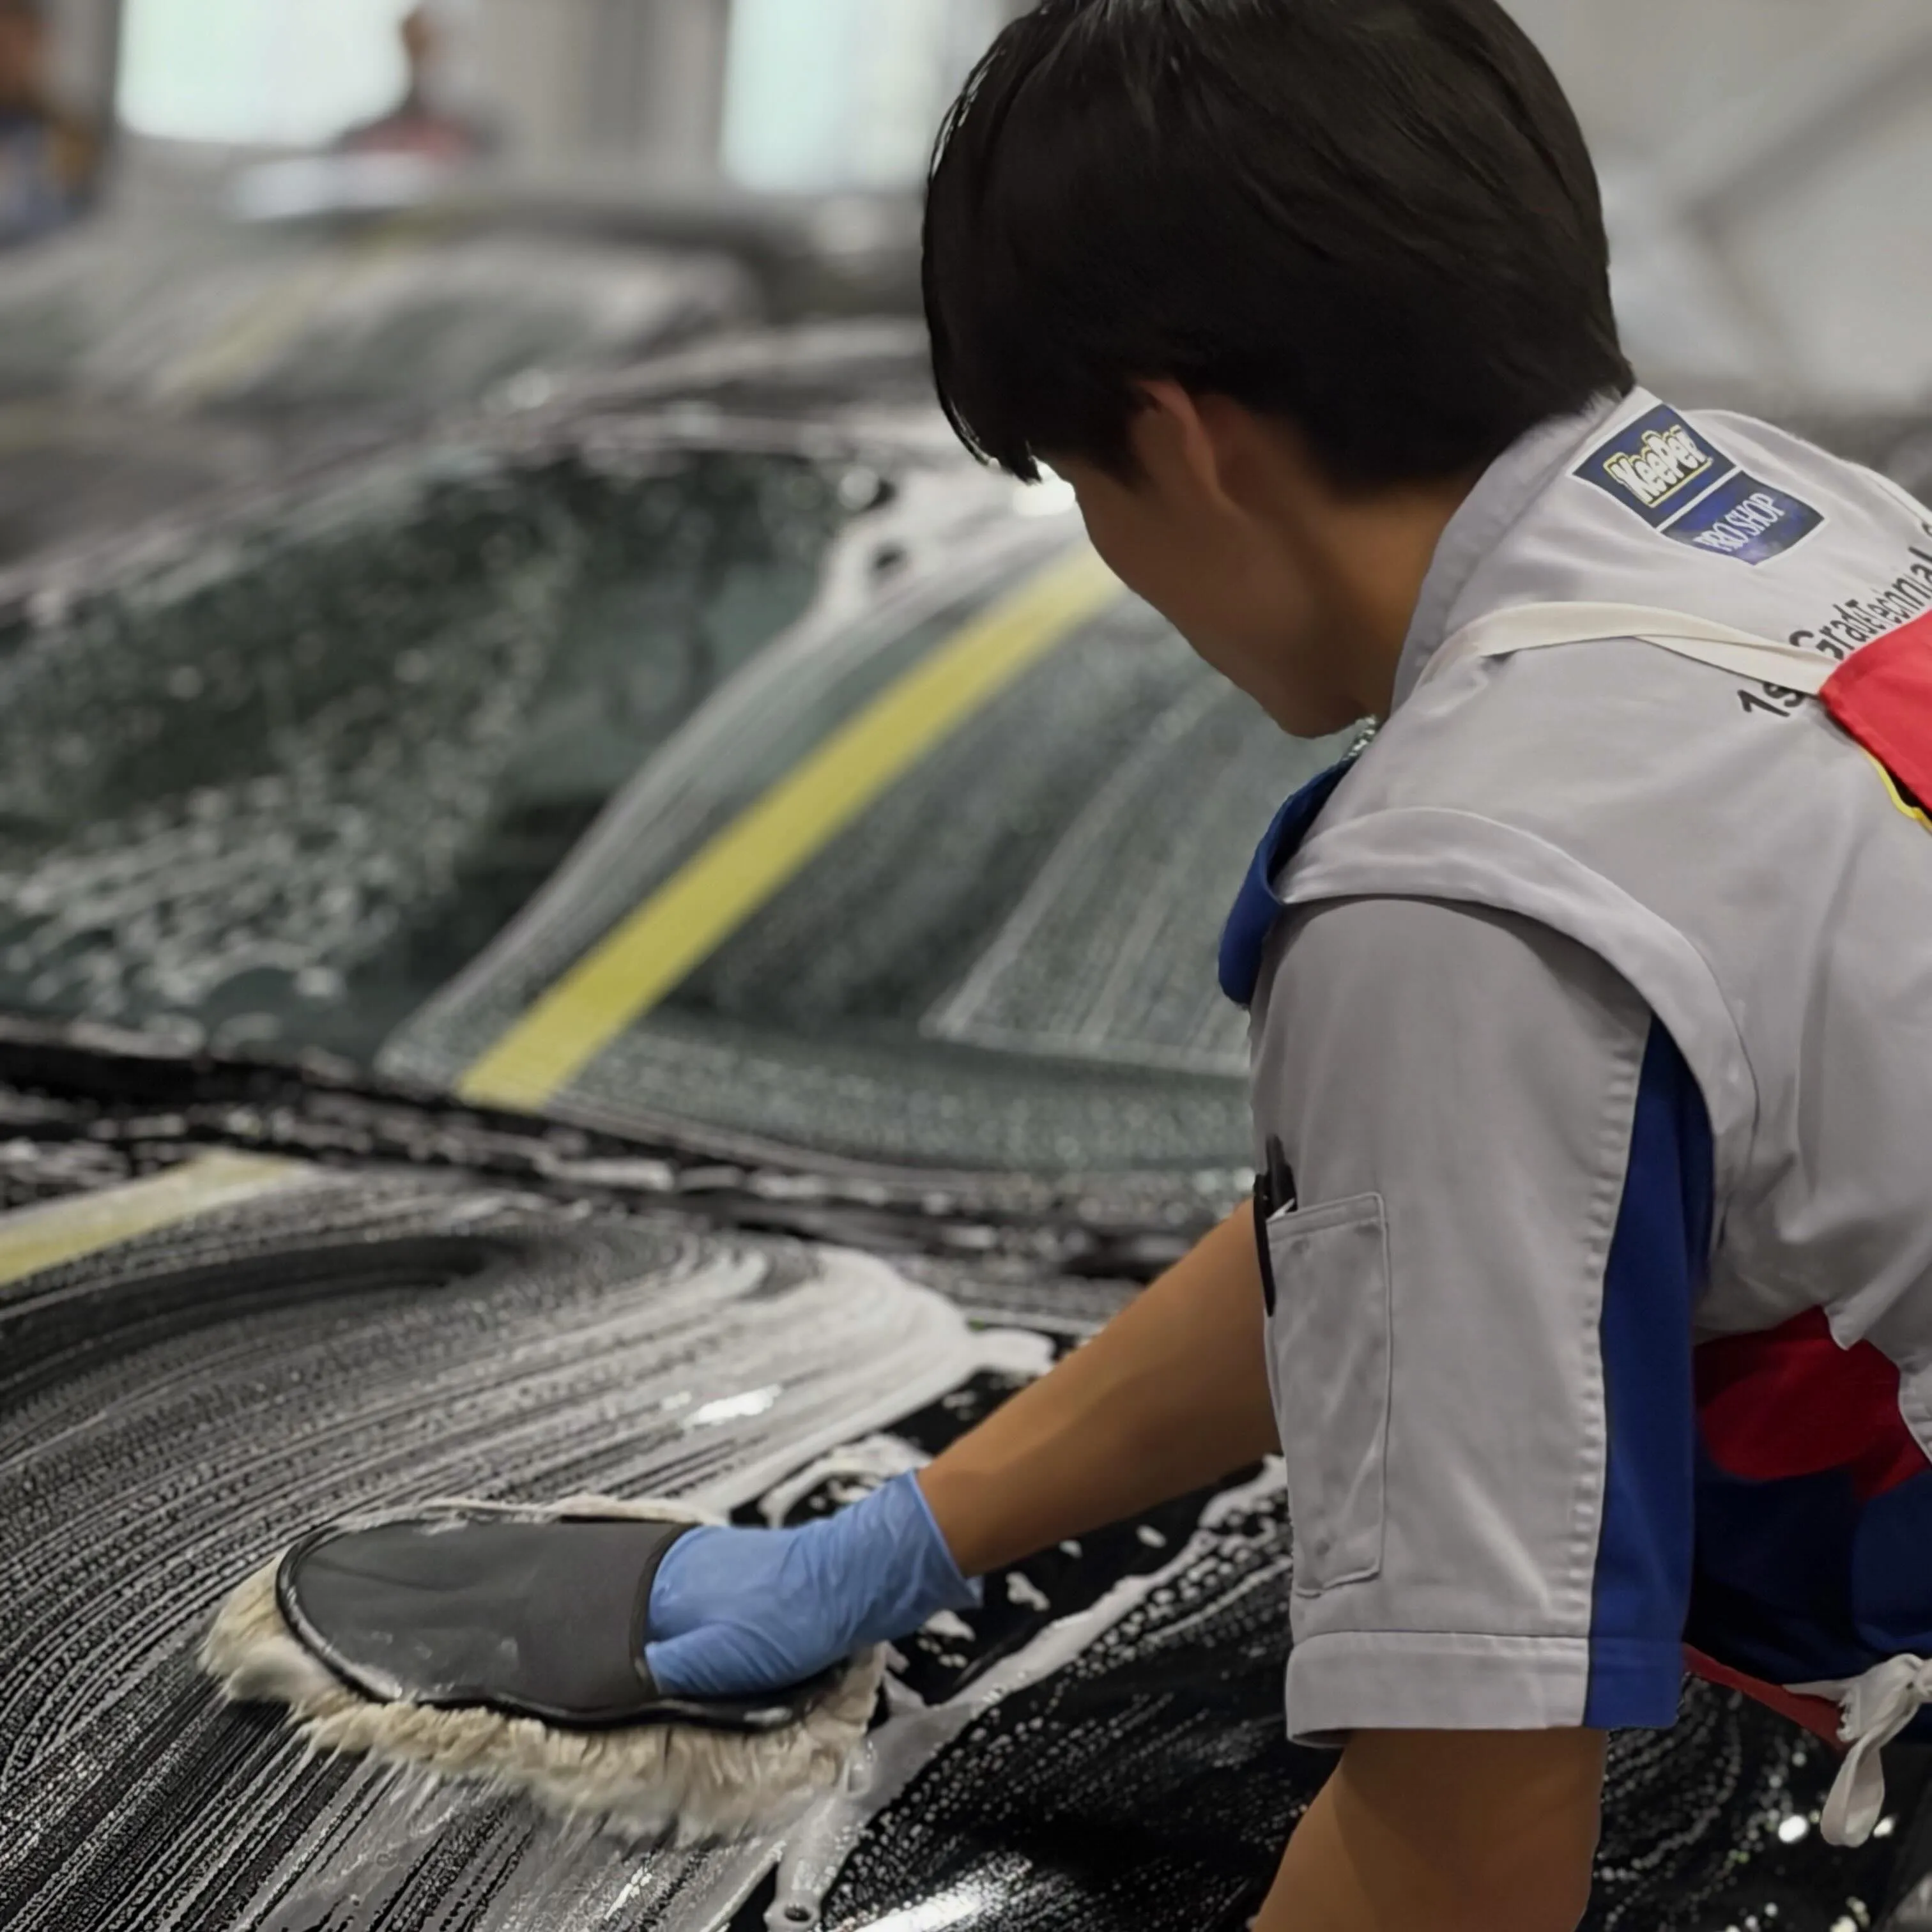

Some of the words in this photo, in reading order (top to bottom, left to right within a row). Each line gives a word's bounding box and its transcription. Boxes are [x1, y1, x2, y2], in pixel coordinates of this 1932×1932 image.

[1693, 521, 1749, 552] PRO
[1724, 492, 1784, 537] SHOP
[1737, 682, 1806, 717] 1s
